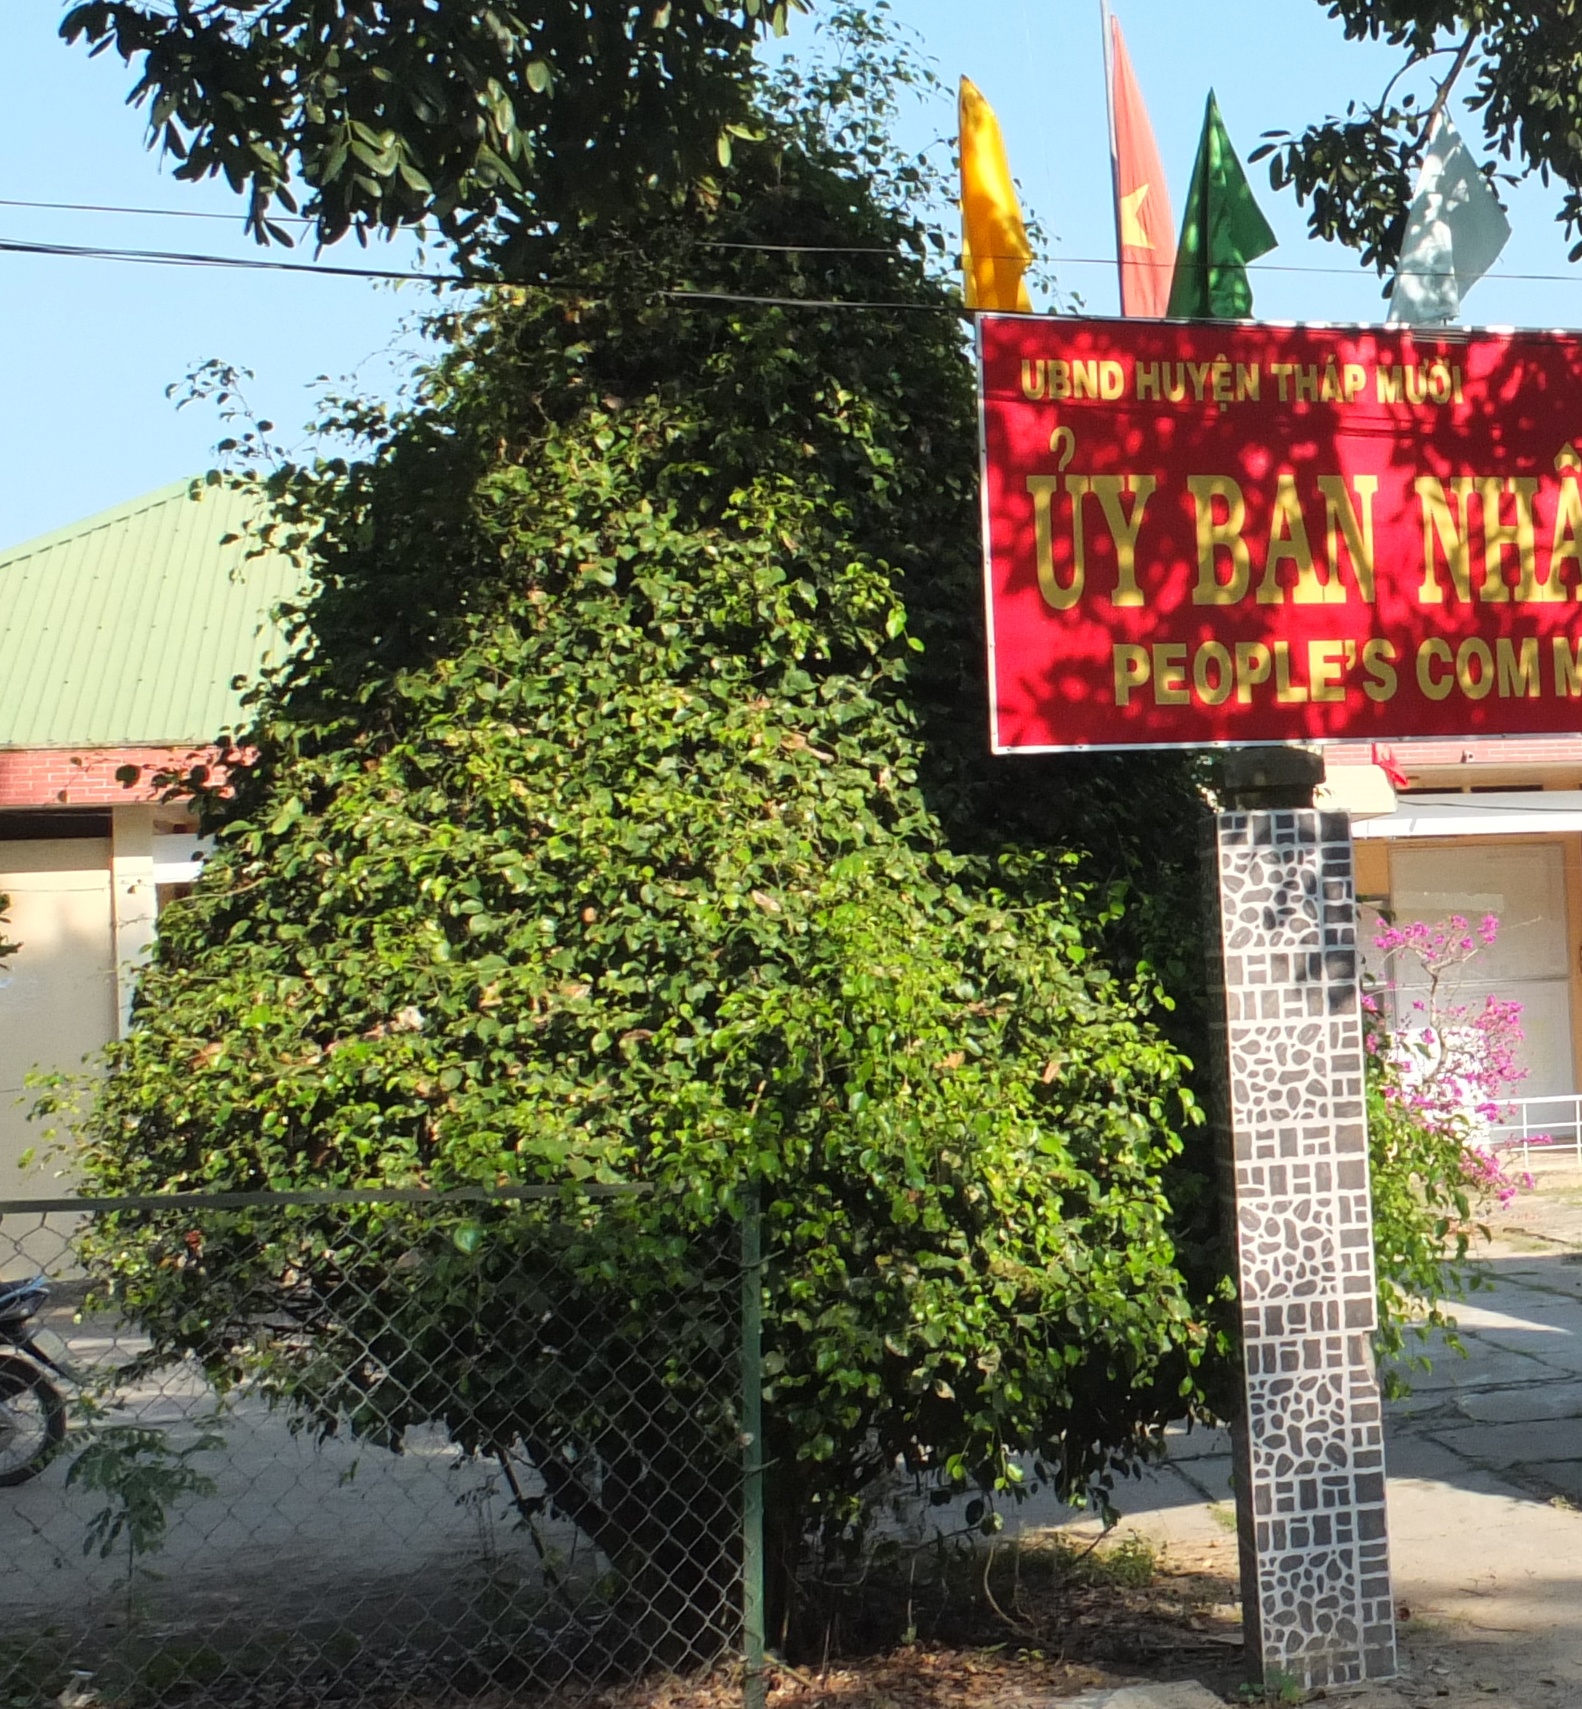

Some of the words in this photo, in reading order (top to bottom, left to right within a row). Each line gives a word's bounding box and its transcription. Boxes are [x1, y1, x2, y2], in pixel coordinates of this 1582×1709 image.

[1021, 359, 1124, 401] UBND
[1136, 354, 1260, 411] HUYỆN
[1271, 355, 1367, 404] THÁP
[1025, 425, 1158, 610] ỦY
[1187, 474, 1379, 606] BAN
[1113, 638, 1398, 706] PEOPLE'S
